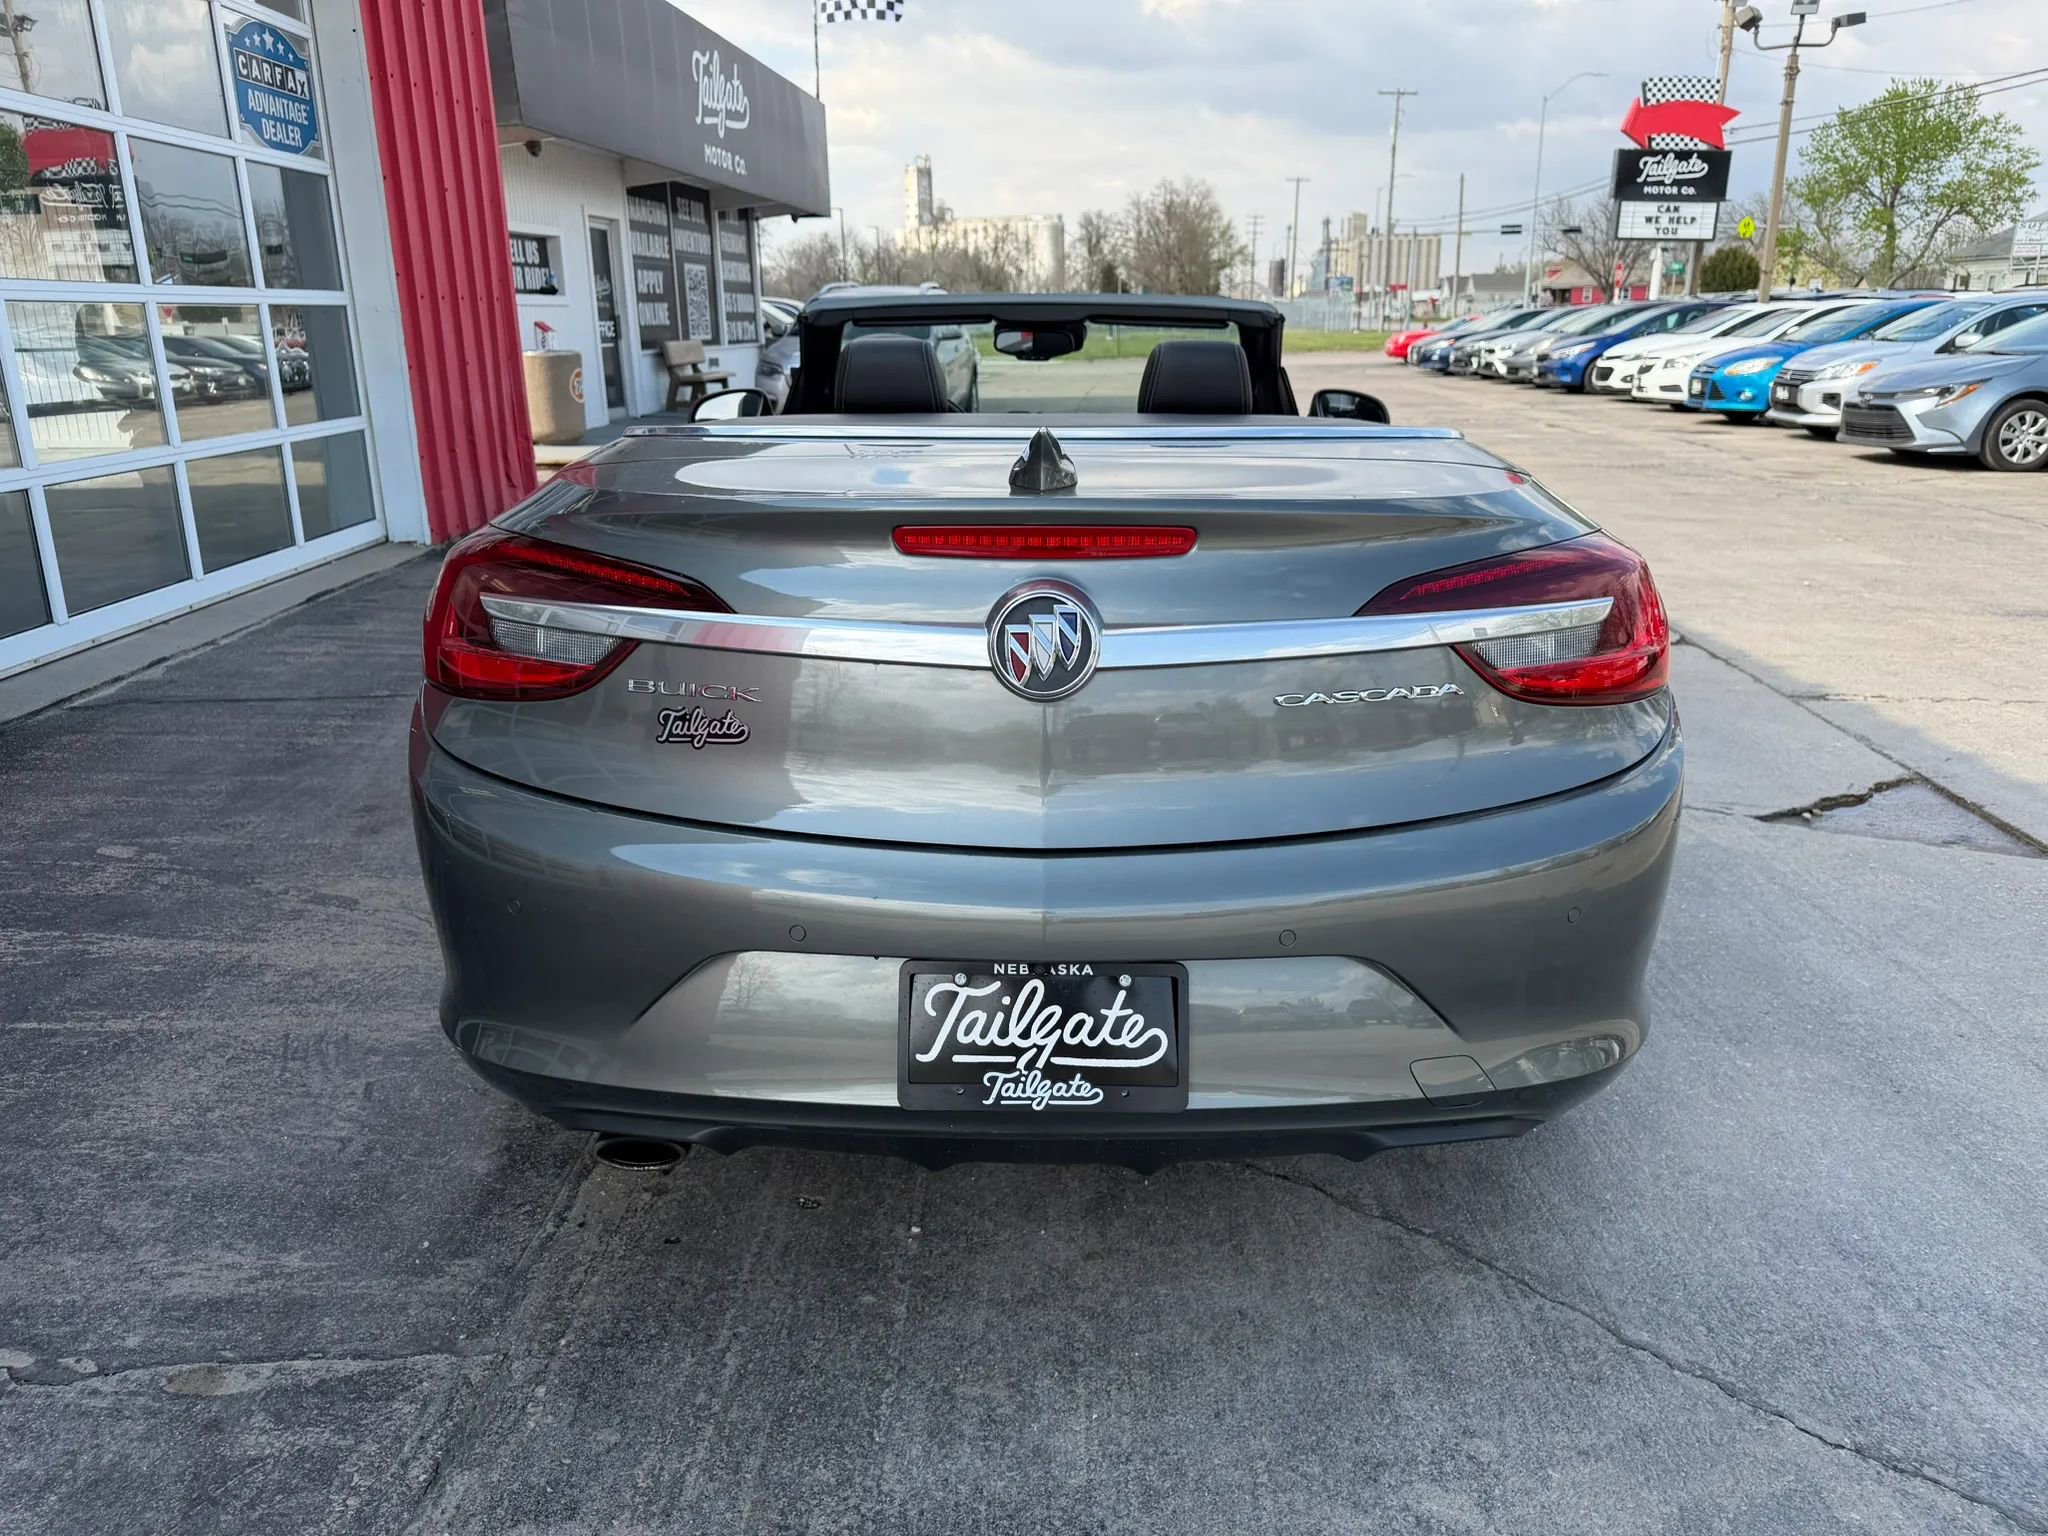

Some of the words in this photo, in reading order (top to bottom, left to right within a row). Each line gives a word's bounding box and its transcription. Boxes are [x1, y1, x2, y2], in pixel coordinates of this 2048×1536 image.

[238, 54, 308, 98] CARFAX
[247, 88, 309, 125] ADVANTAGE
[691, 49, 750, 139] Tailgate
[261, 117, 302, 147] DEALER
[704, 143, 733, 171] MOTOR
[1636, 152, 1709, 184] Tailgate
[1643, 185, 1679, 195] MOTOR
[1644, 216, 1661, 225] WE
[1668, 216, 1697, 225] HELP
[1656, 204, 1680, 214] CAN
[1655, 227, 1679, 236] YOU
[510, 239, 525, 263] ELL
[524, 240, 540, 265] US
[637, 269, 664, 294] APPLY
[627, 679, 763, 703] BUICK
[1274, 682, 1465, 707] CASCADA
[656, 705, 750, 750] Tailgate
[993, 963, 1094, 976] NEBASKA
[915, 978, 1169, 1071] Tailgate
[982, 1069, 1105, 1111] Tailgate
